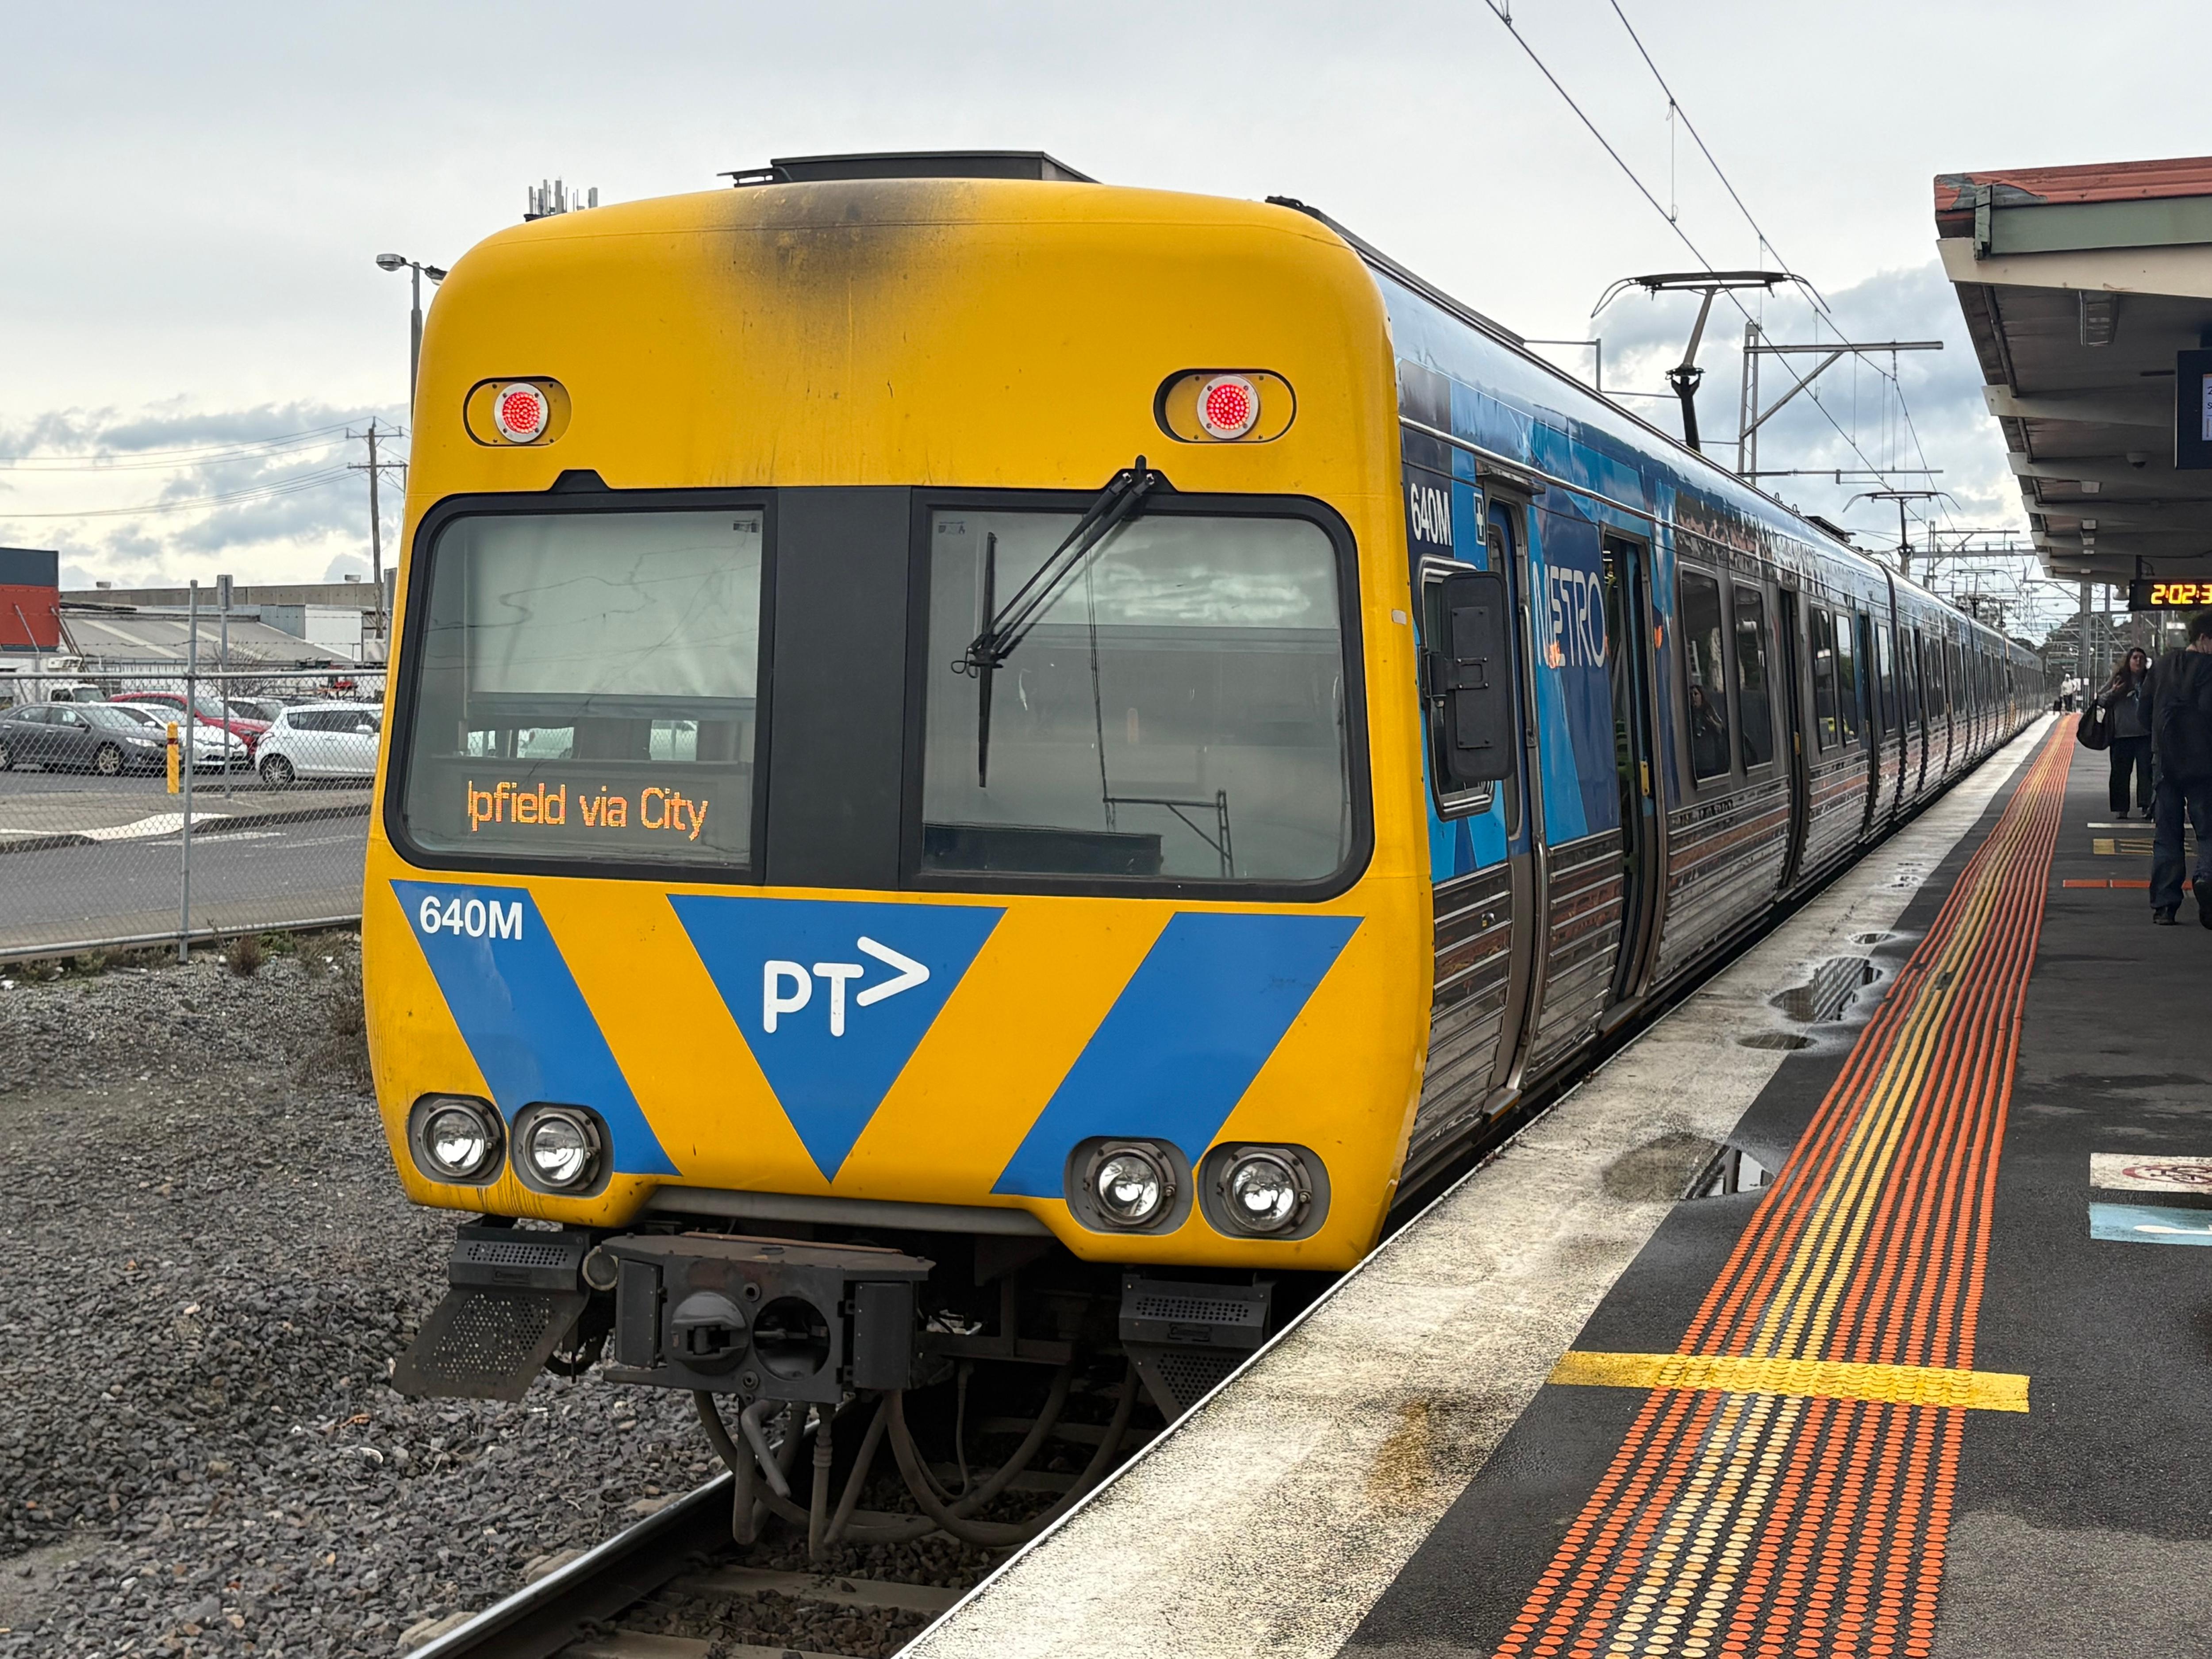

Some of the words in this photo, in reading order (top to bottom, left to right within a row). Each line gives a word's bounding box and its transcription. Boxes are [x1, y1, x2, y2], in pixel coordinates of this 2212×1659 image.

[1410, 483, 1452, 546] 640M
[1532, 561, 1605, 668] METRO
[579, 785, 628, 827] via
[641, 787, 709, 841] City
[420, 895, 522, 941] 640M
